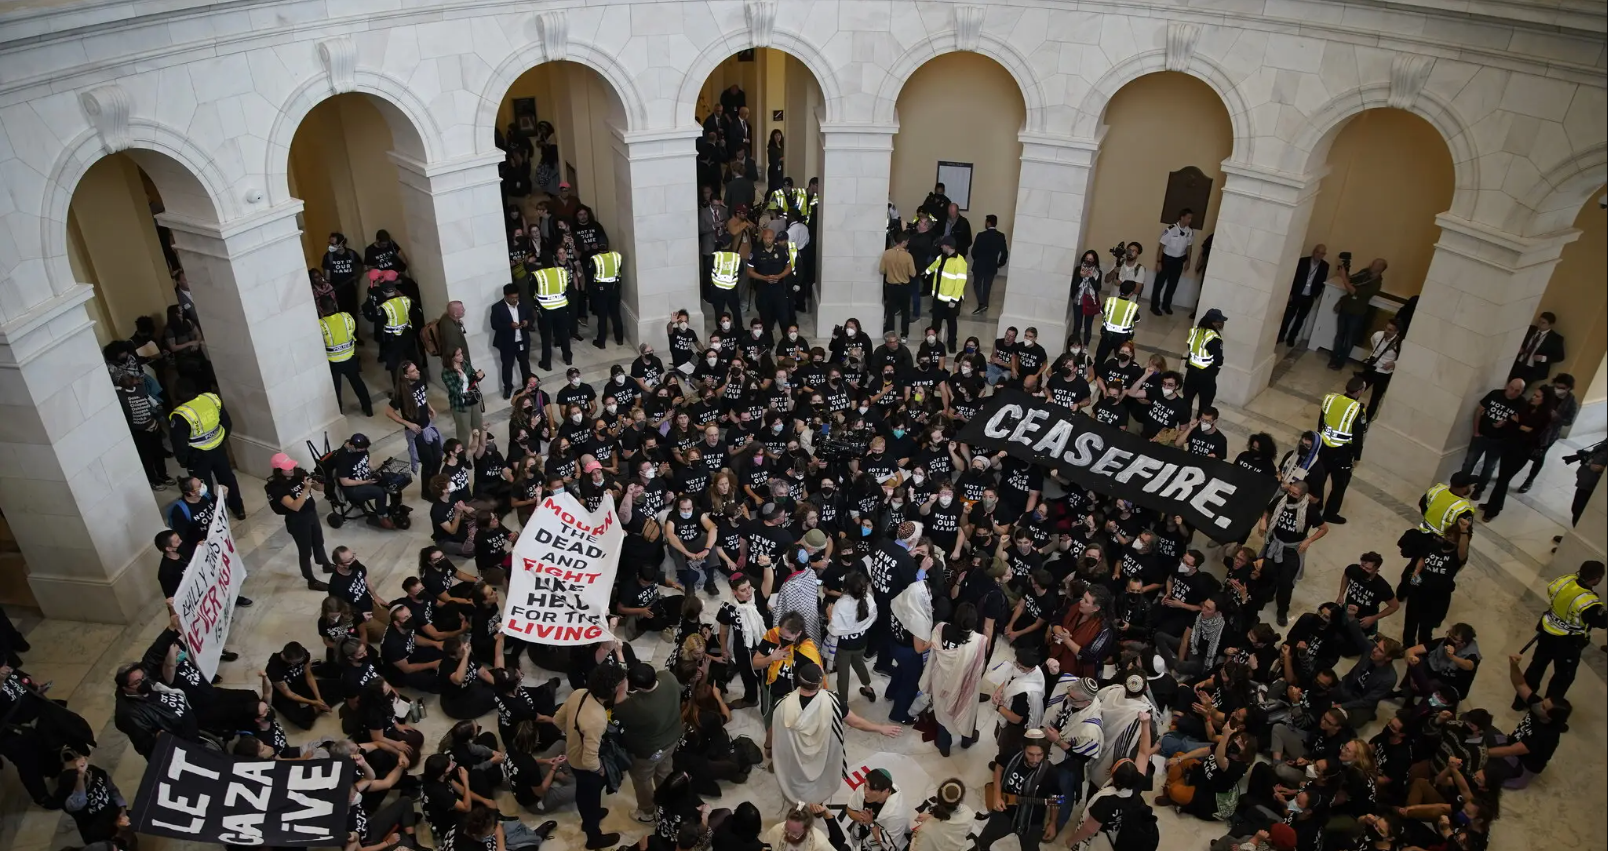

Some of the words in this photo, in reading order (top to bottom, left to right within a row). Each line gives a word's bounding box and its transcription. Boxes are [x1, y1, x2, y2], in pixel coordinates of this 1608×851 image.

[830, 404, 850, 412] NAME
[1153, 400, 1164, 410] NOT
[1490, 400, 1504, 409] NOT
[1149, 410, 1169, 426] NAME
[1152, 407, 1169, 419] OUR
[1490, 407, 1507, 418] OUR
[1192, 438, 1204, 447] NOT
[1193, 445, 1209, 454] OUR
[984, 404, 1237, 529] CEASEFIRE.
[194, 510, 206, 521] NOT
[544, 498, 612, 536] MOURN
[561, 522, 598, 543] THE
[750, 534, 777, 549] JEWS
[752, 542, 771, 553] SAY
[1074, 540, 1086, 550] NOT
[541, 553, 587, 569] AND
[875, 549, 898, 568] JEWS
[876, 560, 890, 572] SAY
[1124, 554, 1135, 565] NOT
[1135, 562, 1144, 570] IN
[523, 558, 601, 584] FIGHT
[1123, 561, 1137, 574] OUR
[638, 591, 650, 599] NOT
[1184, 584, 1191, 592] IN
[511, 606, 557, 622] FOR
[187, 586, 222, 660] NEVER
[508, 619, 602, 640] LIVING
[1209, 754, 1217, 771] OUR
[152, 746, 220, 834] LET
[218, 761, 276, 846] GAZA
